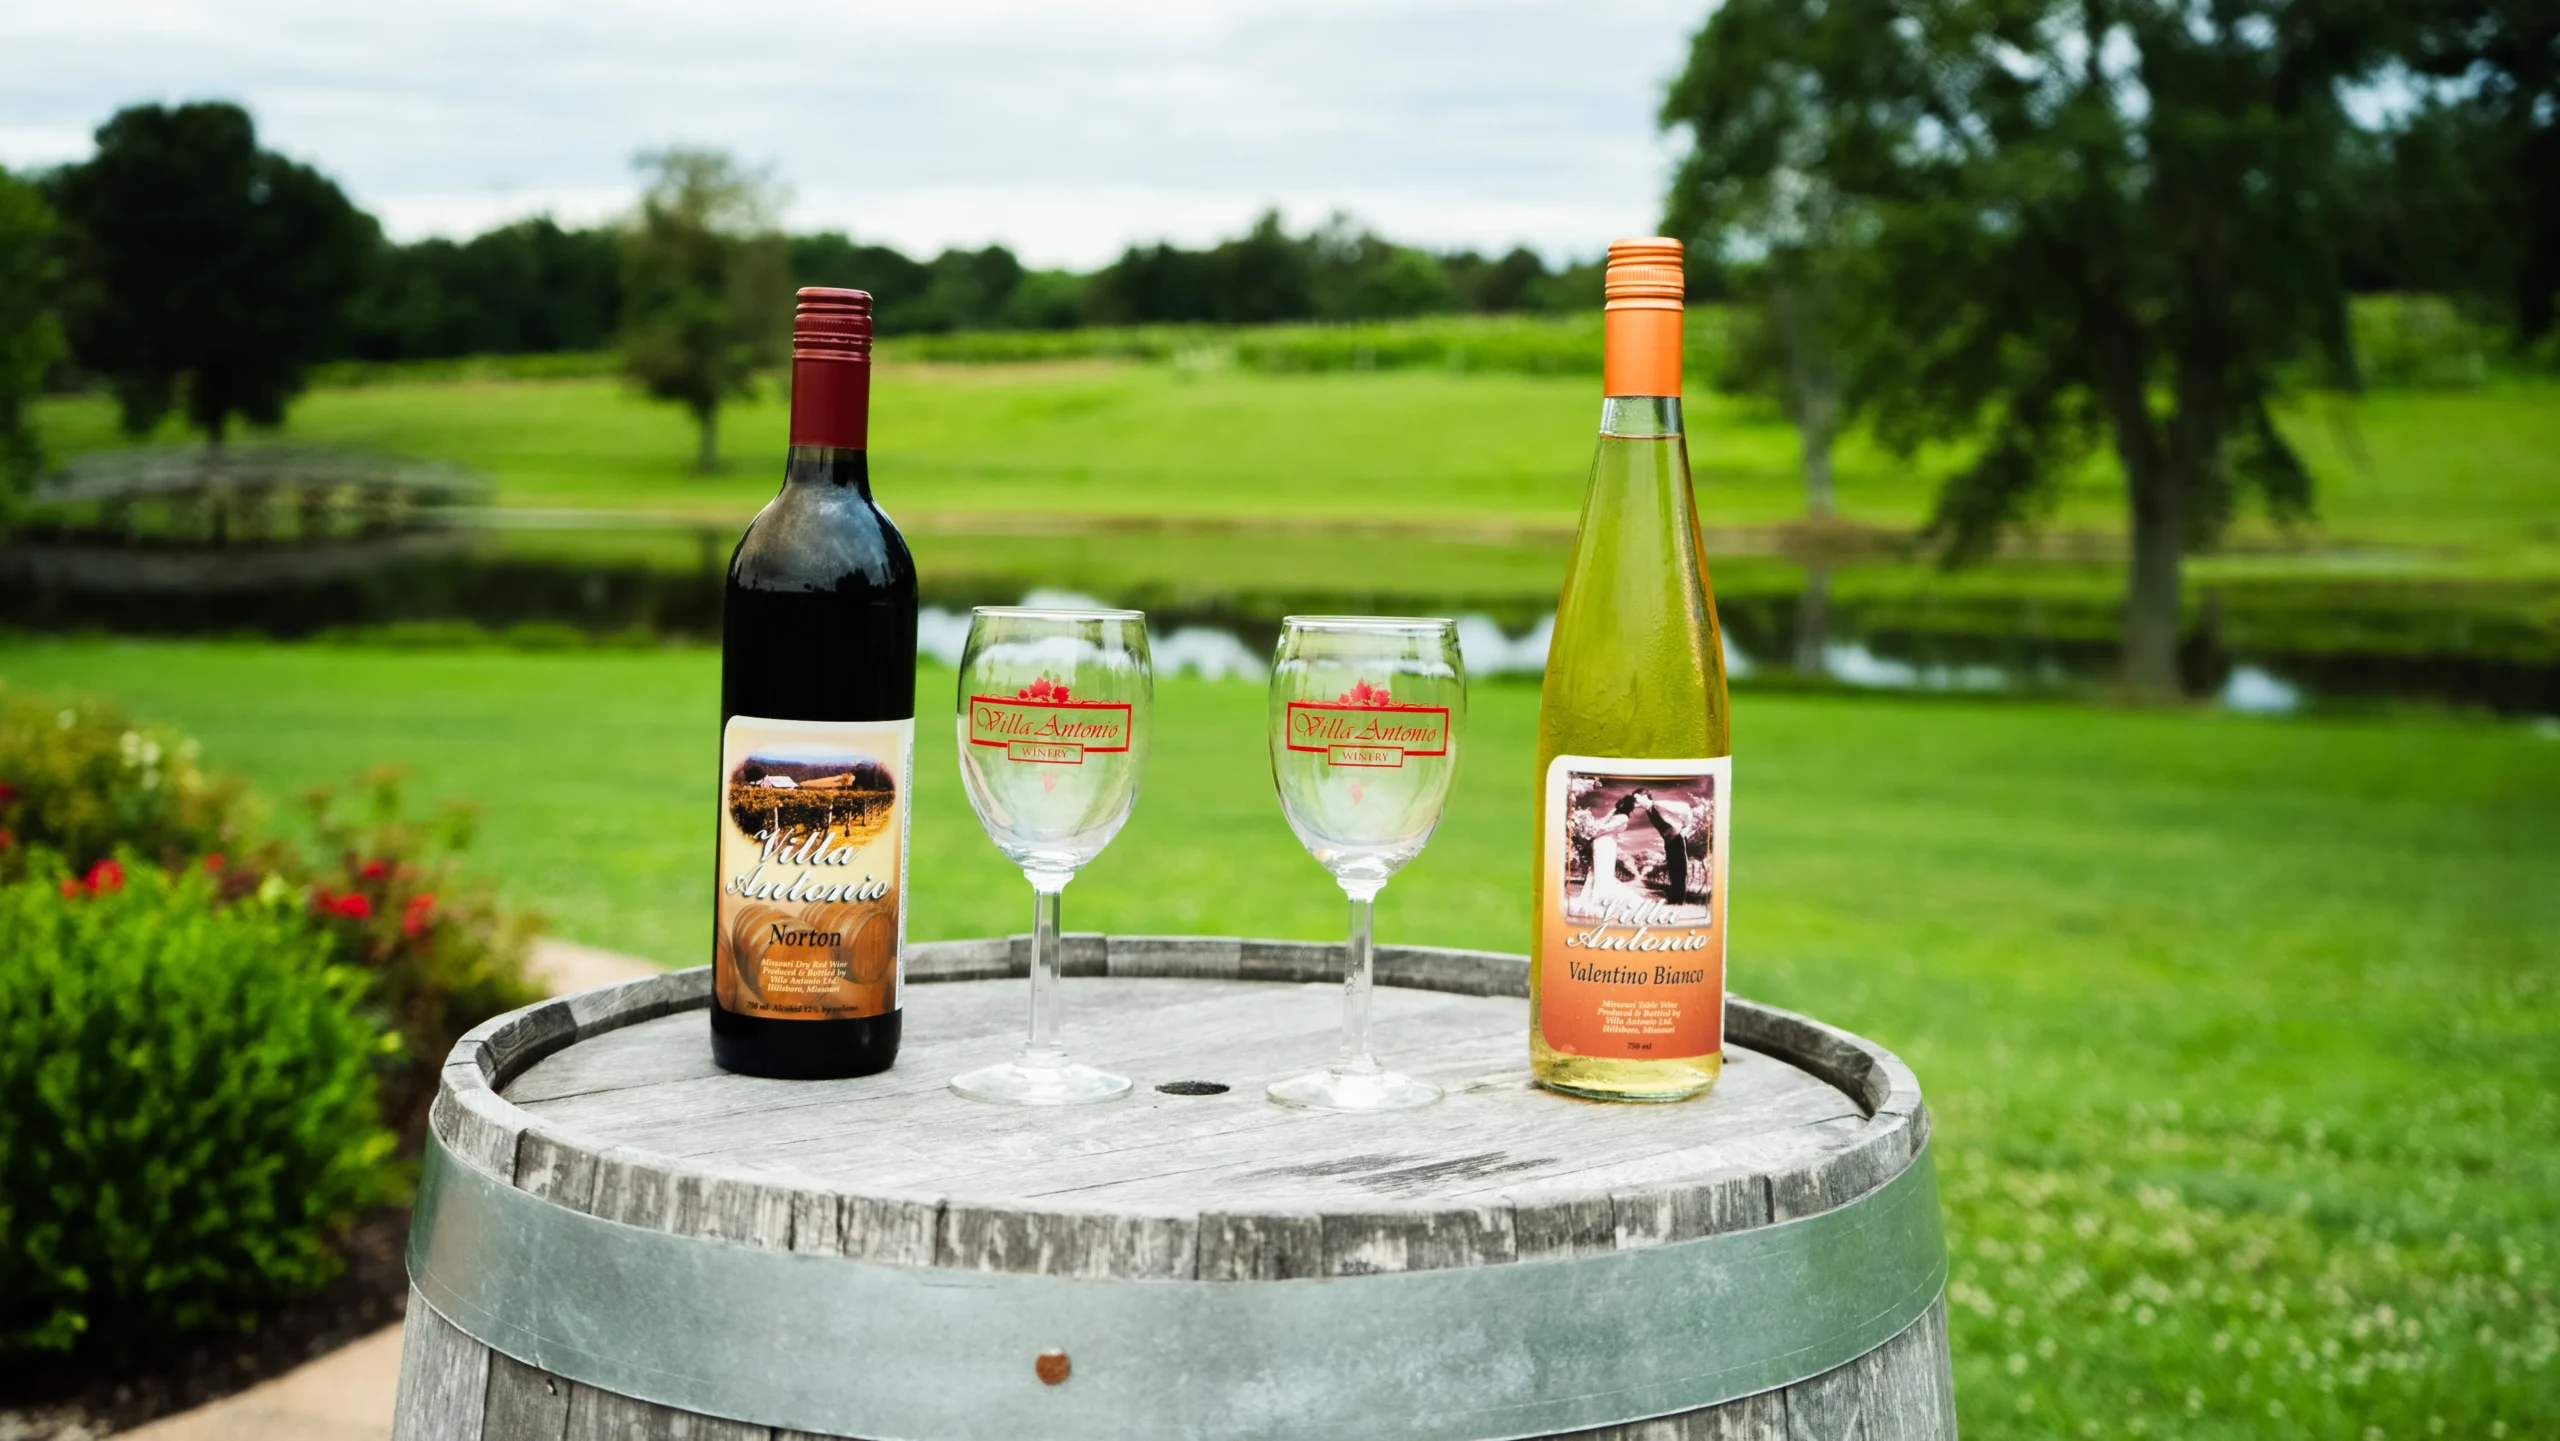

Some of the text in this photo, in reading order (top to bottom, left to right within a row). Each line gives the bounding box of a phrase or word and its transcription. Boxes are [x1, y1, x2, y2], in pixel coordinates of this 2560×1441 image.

[976, 707, 1119, 739] Villa Antonio
[1294, 713, 1438, 742] Villa Antonio
[1022, 747, 1069, 758] WINERY
[1342, 752, 1389, 762] WINERY
[753, 828, 860, 866] Villa
[725, 863, 892, 903] Antonio
[1601, 898, 1679, 924] Villa
[769, 924, 842, 947] Norton
[1566, 923, 1711, 952] Antonio
[761, 958, 848, 969] Missouri Dry Red Wine
[762, 967, 796, 976] Produced
[807, 968, 836, 977] Bottled
[836, 968, 846, 977] by
[1569, 961, 1704, 985] Valentino Bianco
[770, 976, 838, 985] Villa Antonio Ltd.
[767, 984, 840, 993] Hillsboro, Missouri
[747, 1001, 759, 1010] 750
[772, 1004, 802, 1013] Alcohol
[821, 1005, 831, 1014] by
[1602, 1000, 1679, 1009] Missouri Table Wine
[1597, 1007, 1681, 1019] Produced & Bottled by
[1605, 1016, 1673, 1026] Villa Antonio Ltd.
[1602, 1024, 1675, 1034] Hillsboro, Missouri
[1627, 1042, 1652, 1050] 750 ml
